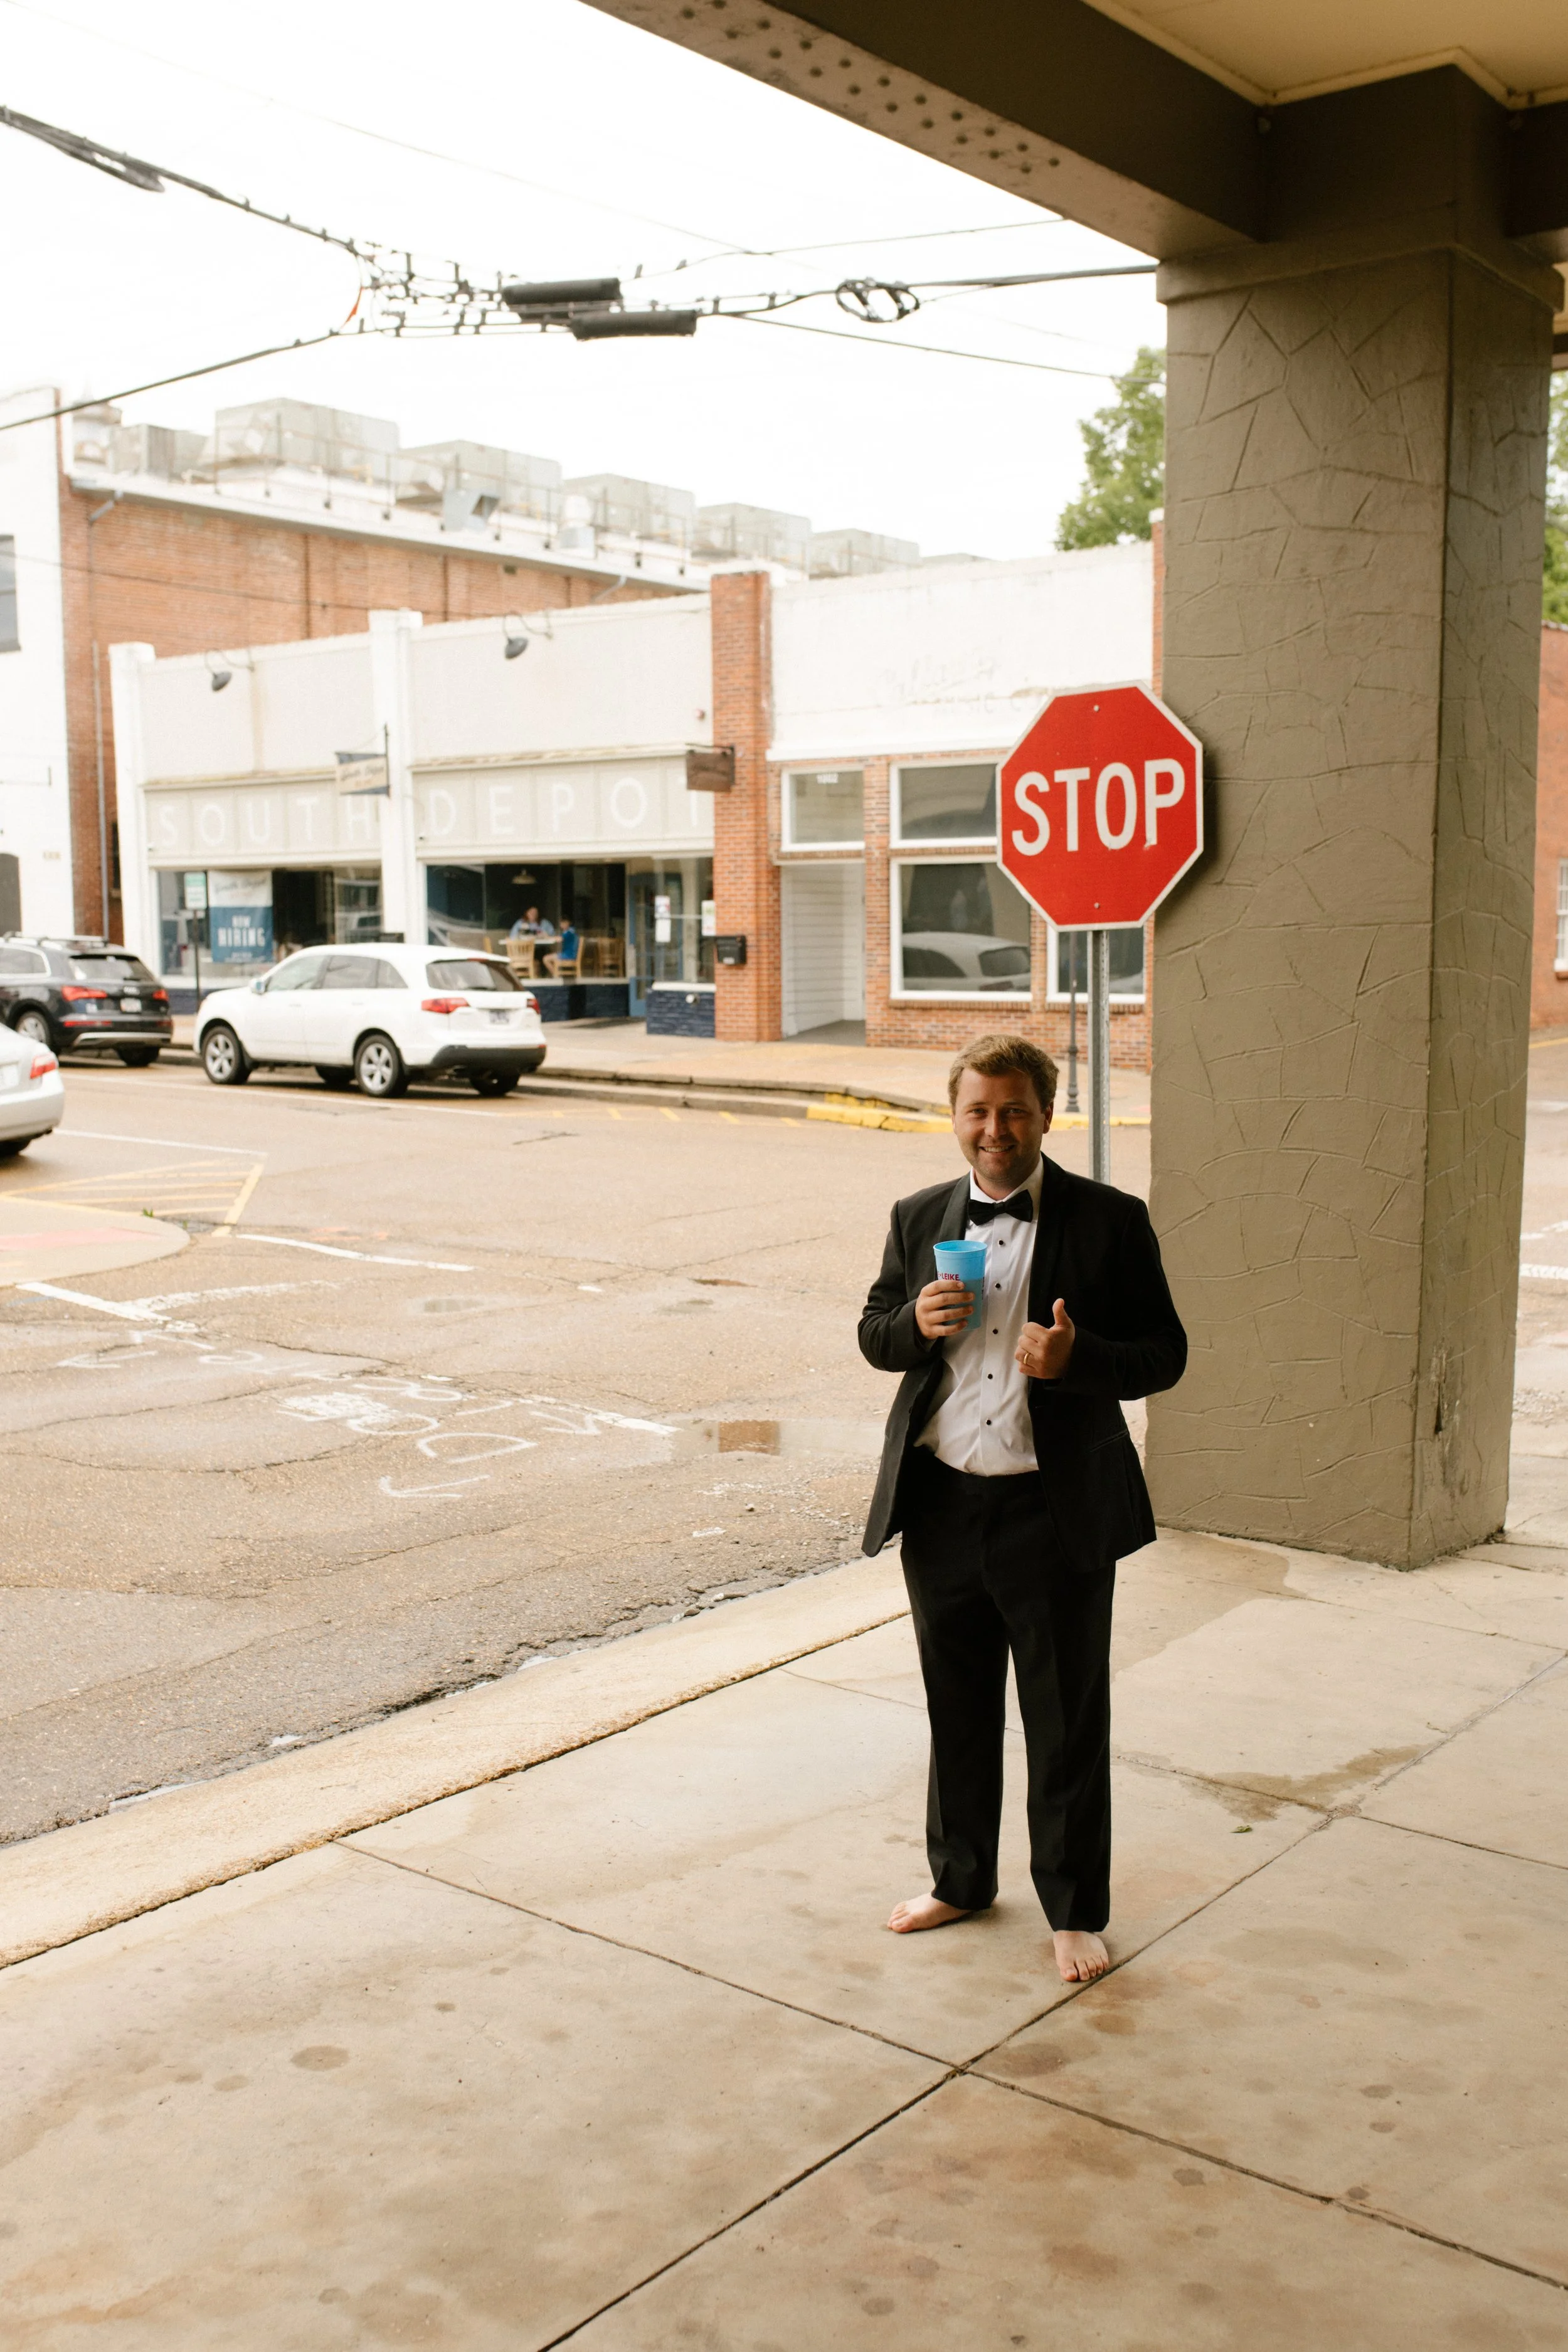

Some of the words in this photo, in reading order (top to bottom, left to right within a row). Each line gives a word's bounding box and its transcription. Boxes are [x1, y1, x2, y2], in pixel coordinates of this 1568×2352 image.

[157, 795, 373, 847] SOUTH
[1012, 758, 1185, 856] STOP
[218, 928, 265, 946] HIRING
